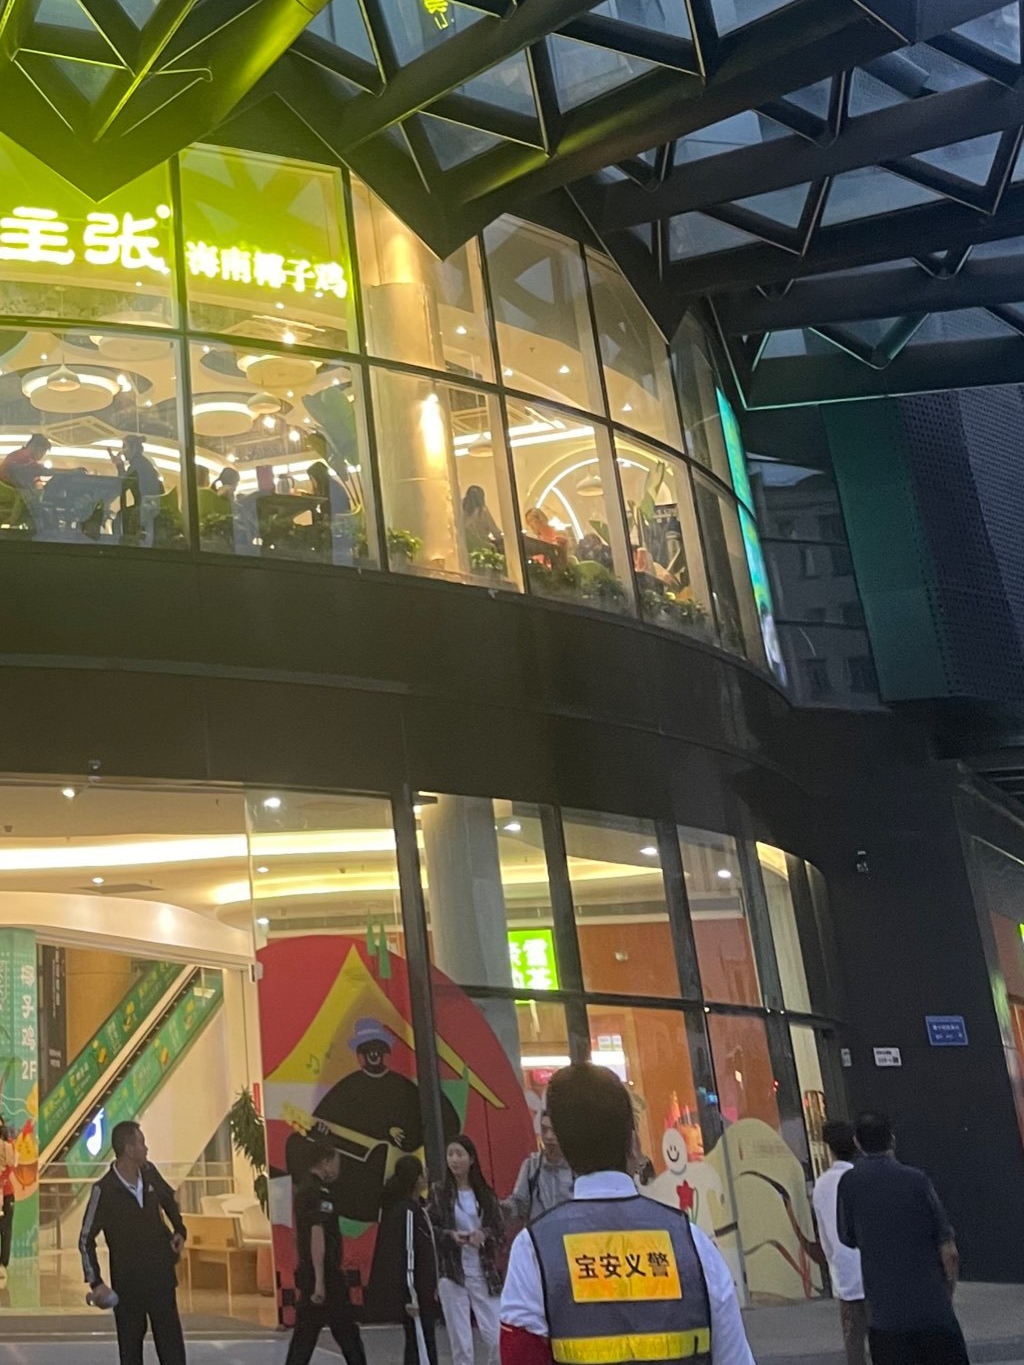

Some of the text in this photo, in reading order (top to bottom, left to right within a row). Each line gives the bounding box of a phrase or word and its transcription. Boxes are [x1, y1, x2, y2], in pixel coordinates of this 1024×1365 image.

[21, 1059, 37, 1081] 2F
[575, 1252, 670, 1279] 宝安义警
